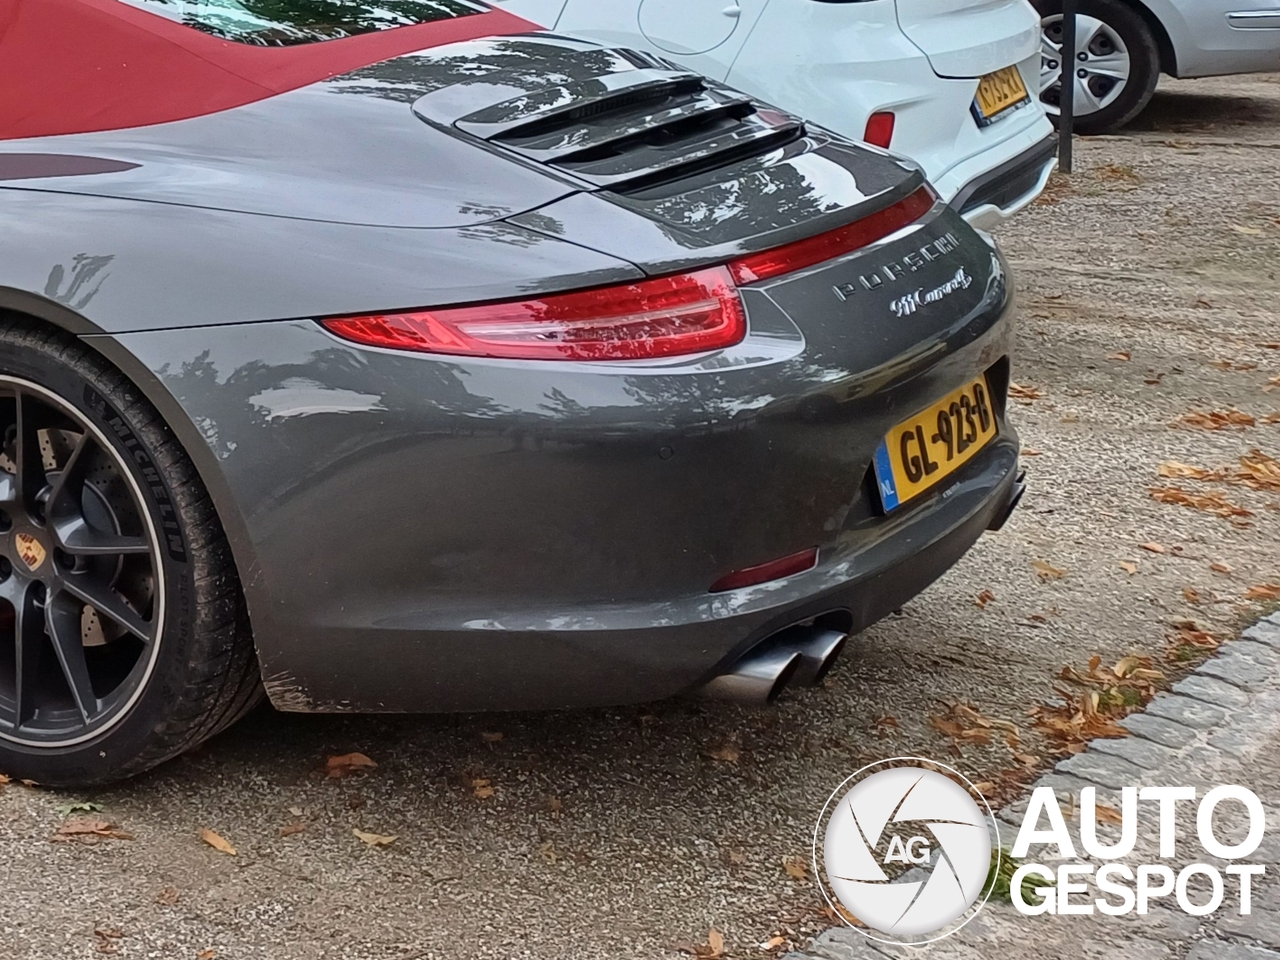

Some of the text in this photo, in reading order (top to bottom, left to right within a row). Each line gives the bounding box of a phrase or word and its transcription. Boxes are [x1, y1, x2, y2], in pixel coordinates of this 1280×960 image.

[890, 294, 917, 317] 911
[900, 383, 990, 483] GL-923-B
[109, 416, 185, 554] MICHELIN
[881, 479, 894, 497] NL
